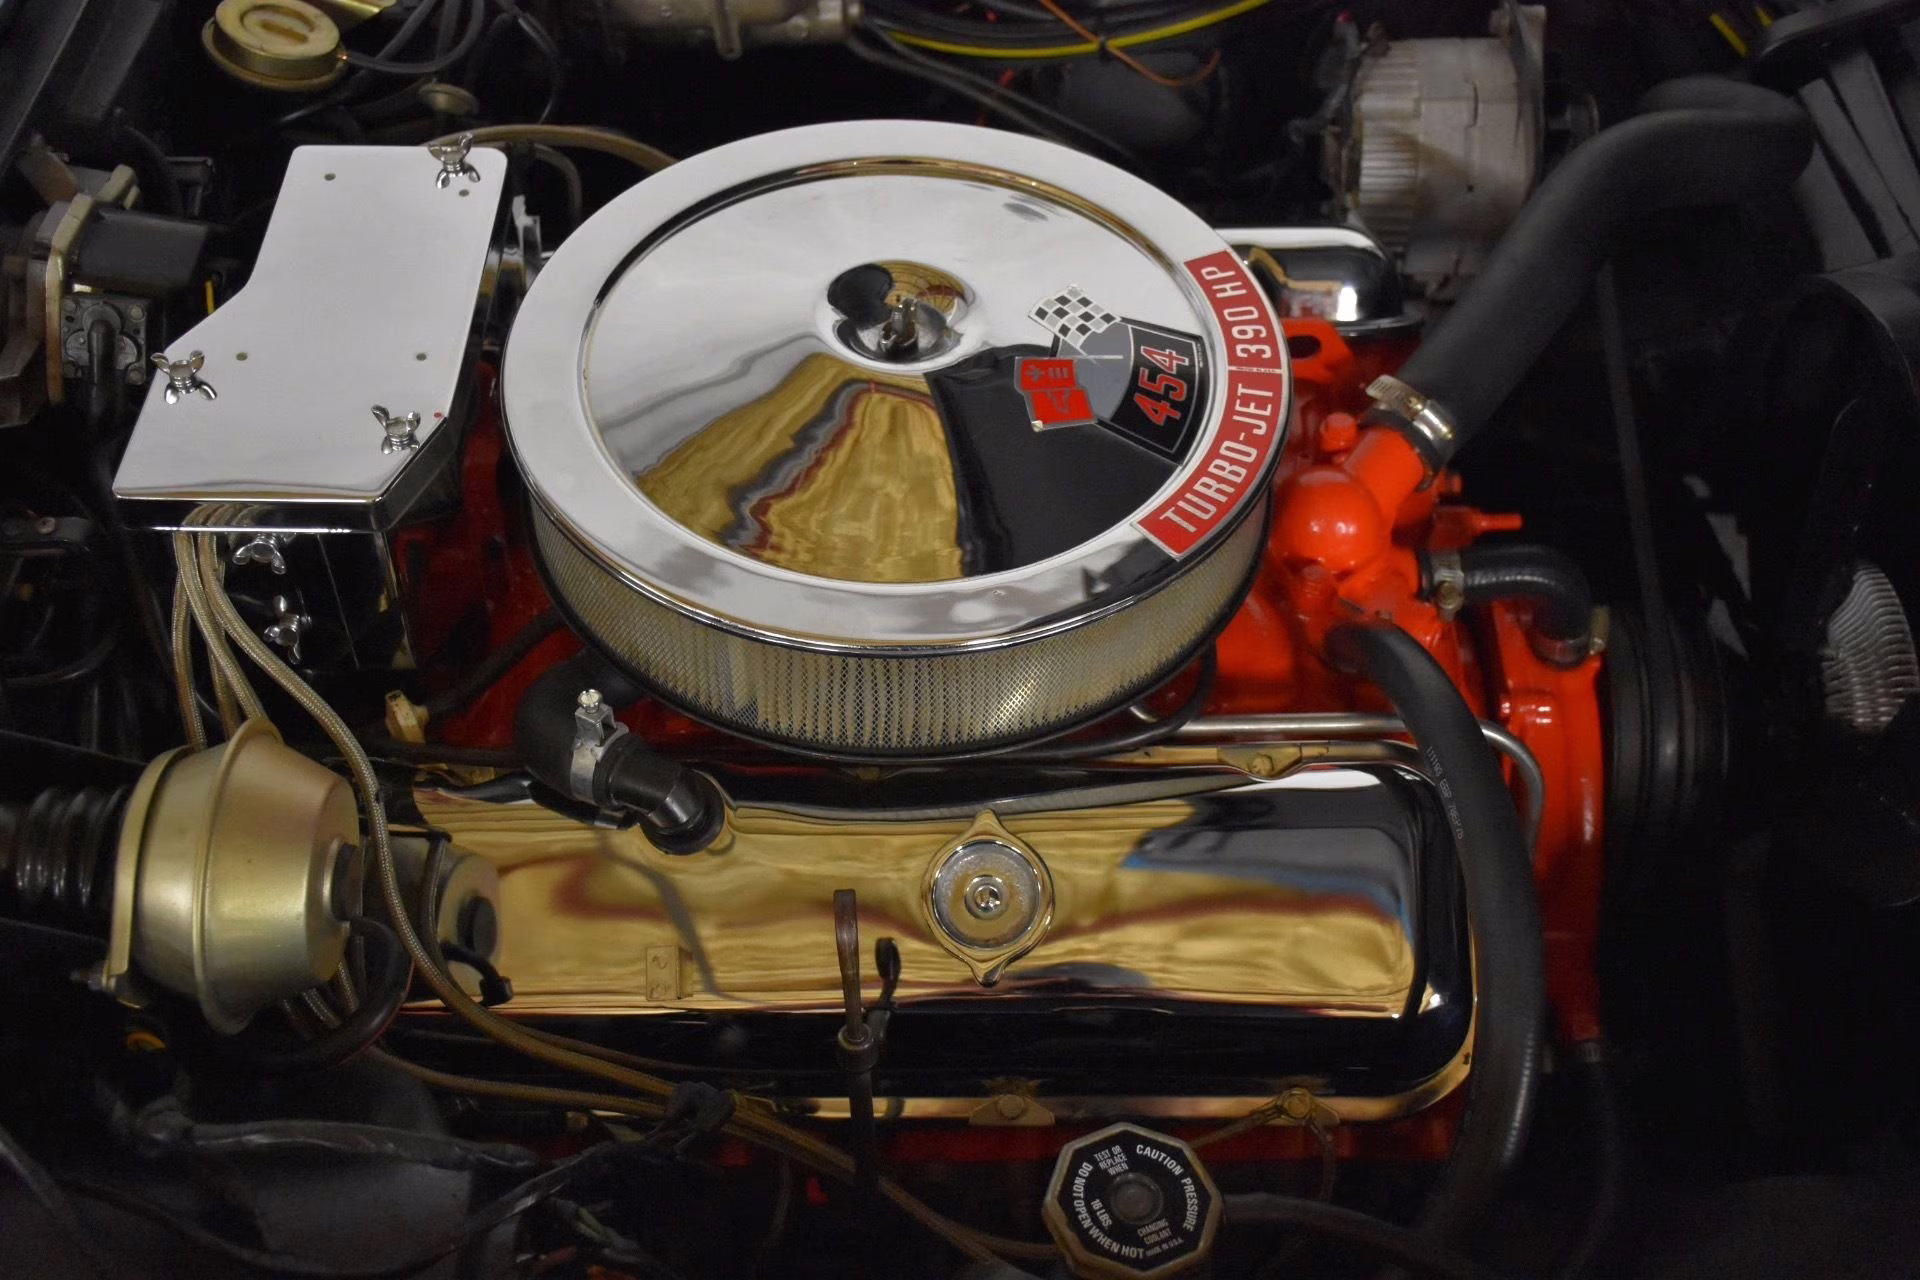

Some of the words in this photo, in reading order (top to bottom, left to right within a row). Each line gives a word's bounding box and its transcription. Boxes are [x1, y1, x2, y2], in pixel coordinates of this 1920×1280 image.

[1201, 266, 1247, 299] HP
[1223, 305, 1272, 359] 390
[1133, 345, 1190, 426] 454
[1159, 384, 1273, 533] TURBO-JET
[1093, 1149, 1111, 1161] TEST
[1111, 1144, 1123, 1155] OR
[1098, 1153, 1128, 1170] REPLACE
[1078, 1161, 1093, 1178] DO
[1107, 1162, 1129, 1175] WHEN
[1072, 1176, 1086, 1199] NOT
[1136, 1144, 1184, 1176] CAUTION
[1180, 1177, 1198, 1232] PRESSURE
[1073, 1199, 1093, 1229] OPEN
[1090, 1198, 1103, 1211] 16
[1088, 1225, 1121, 1253] WHEN
[1121, 1244, 1144, 1259] HOT
